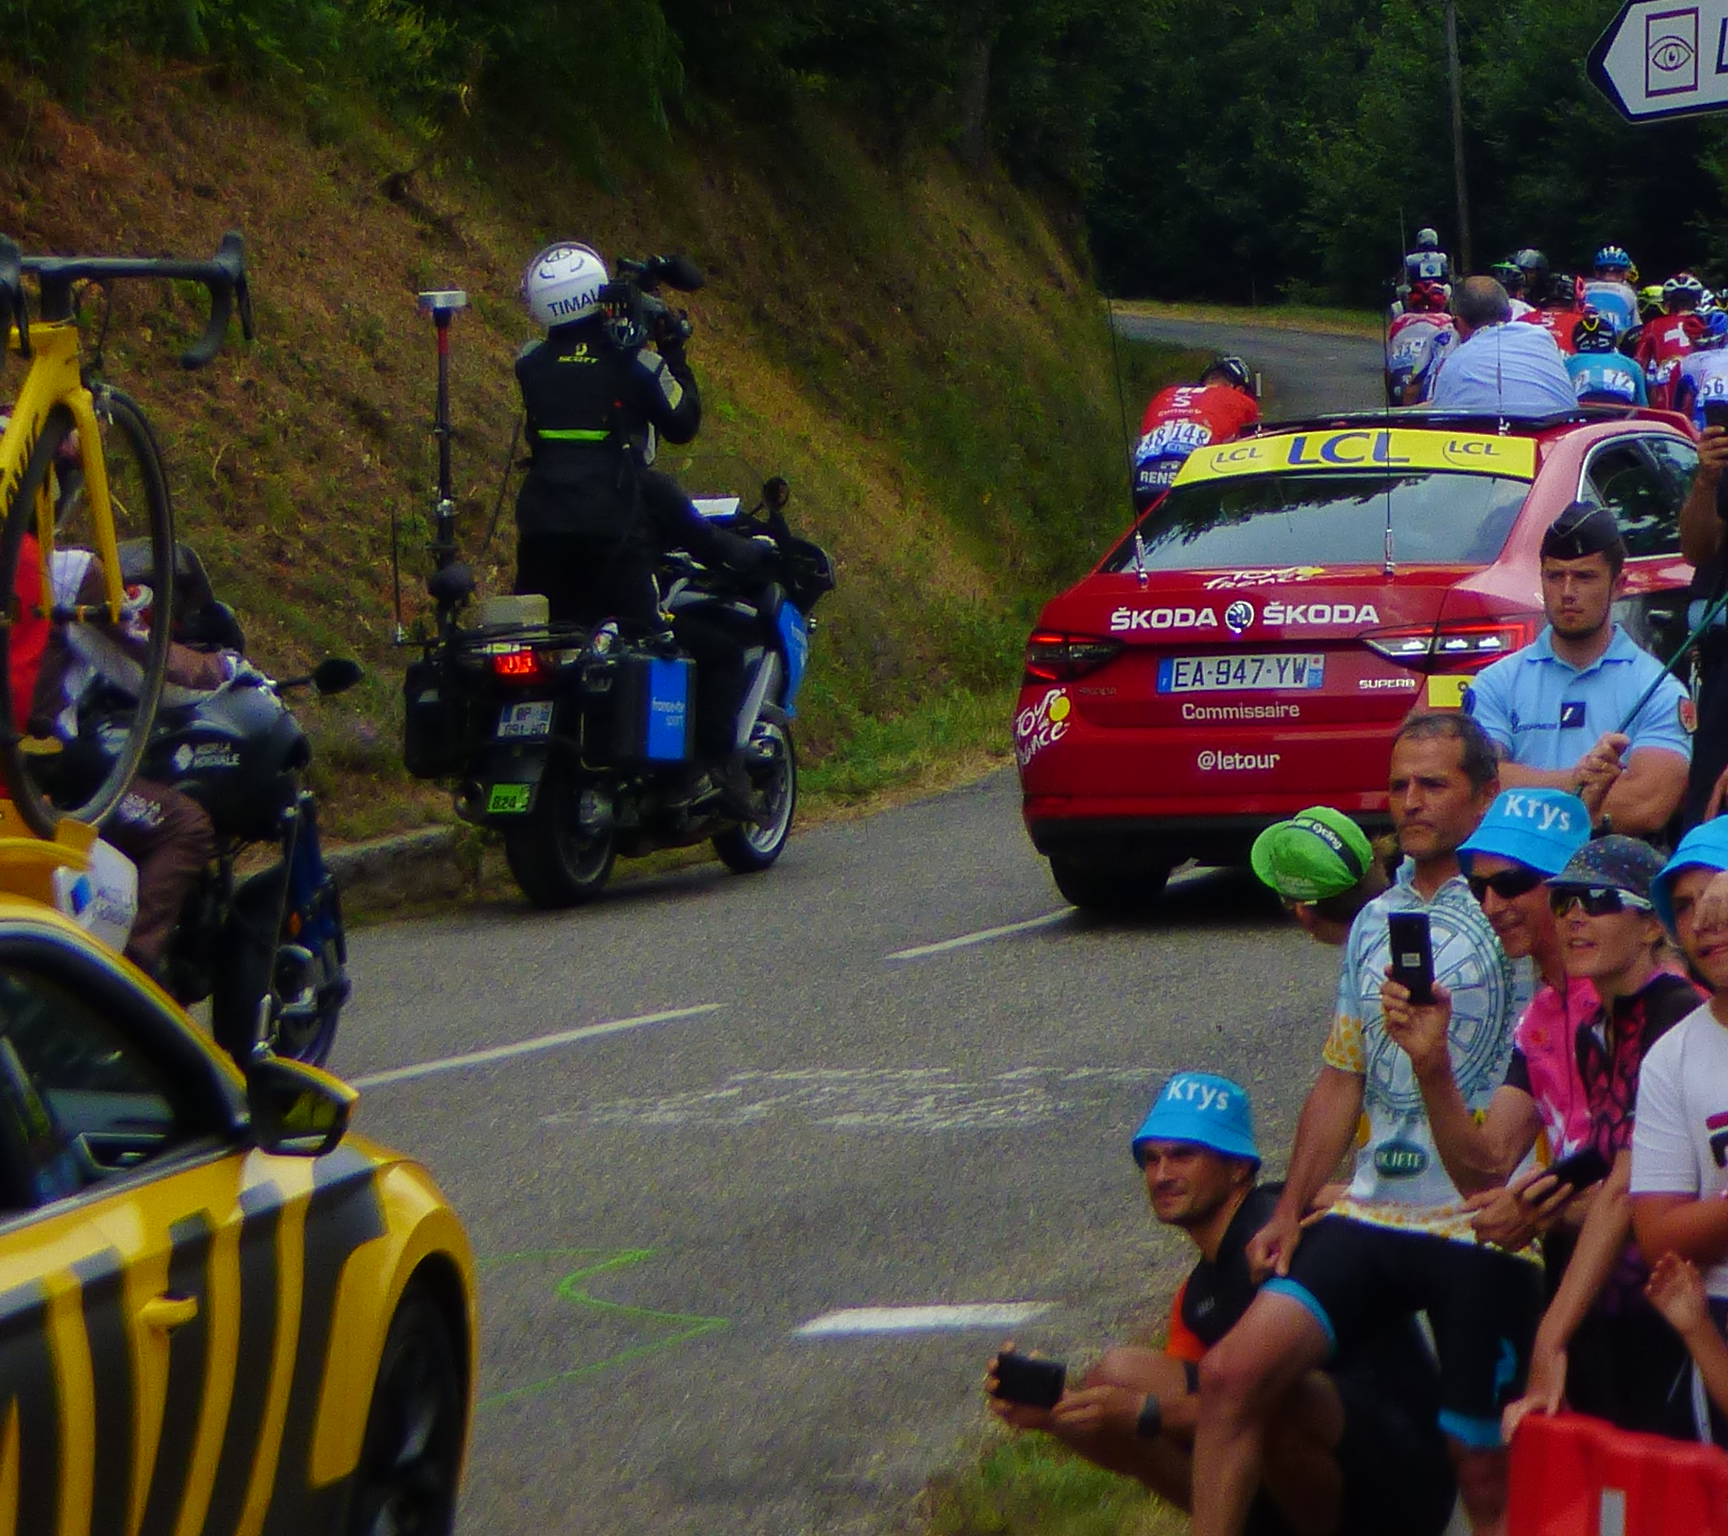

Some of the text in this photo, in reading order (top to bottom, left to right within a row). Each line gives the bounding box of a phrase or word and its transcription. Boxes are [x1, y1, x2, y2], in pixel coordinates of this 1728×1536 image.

[1171, 424, 1208, 447] 148
[1216, 446, 1264, 464] LCL
[1287, 431, 1410, 466] LCL
[1449, 440, 1501, 456] LCL
[1110, 606, 1218, 631] ŠKODA
[1263, 601, 1380, 626] ŠKODA
[1359, 678, 1416, 689] SUPERB
[1182, 702, 1300, 720] Commissaire
[1197, 749, 1280, 771] @letour
[1504, 794, 1570, 831] Krys
[1167, 1077, 1229, 1111] Krys
